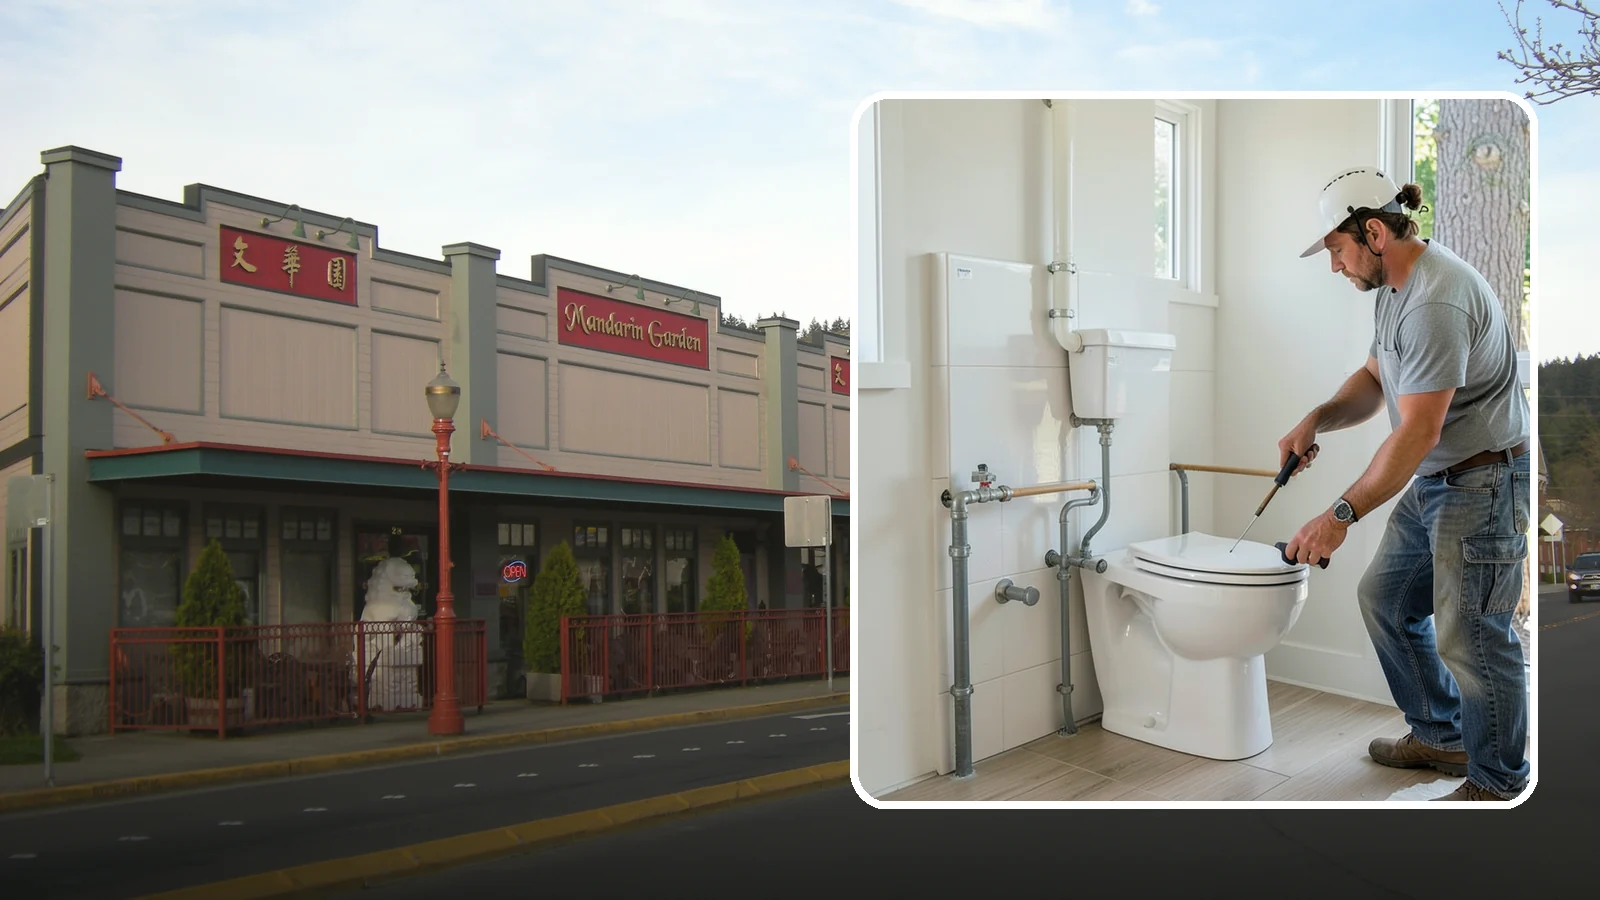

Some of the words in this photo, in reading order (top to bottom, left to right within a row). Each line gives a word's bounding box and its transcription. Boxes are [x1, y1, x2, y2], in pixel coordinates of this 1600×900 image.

[231, 235, 346, 291] 文華園
[564, 302, 644, 341] Mandarin
[648, 320, 701, 352] Garden
[503, 565, 527, 578] OPEN
